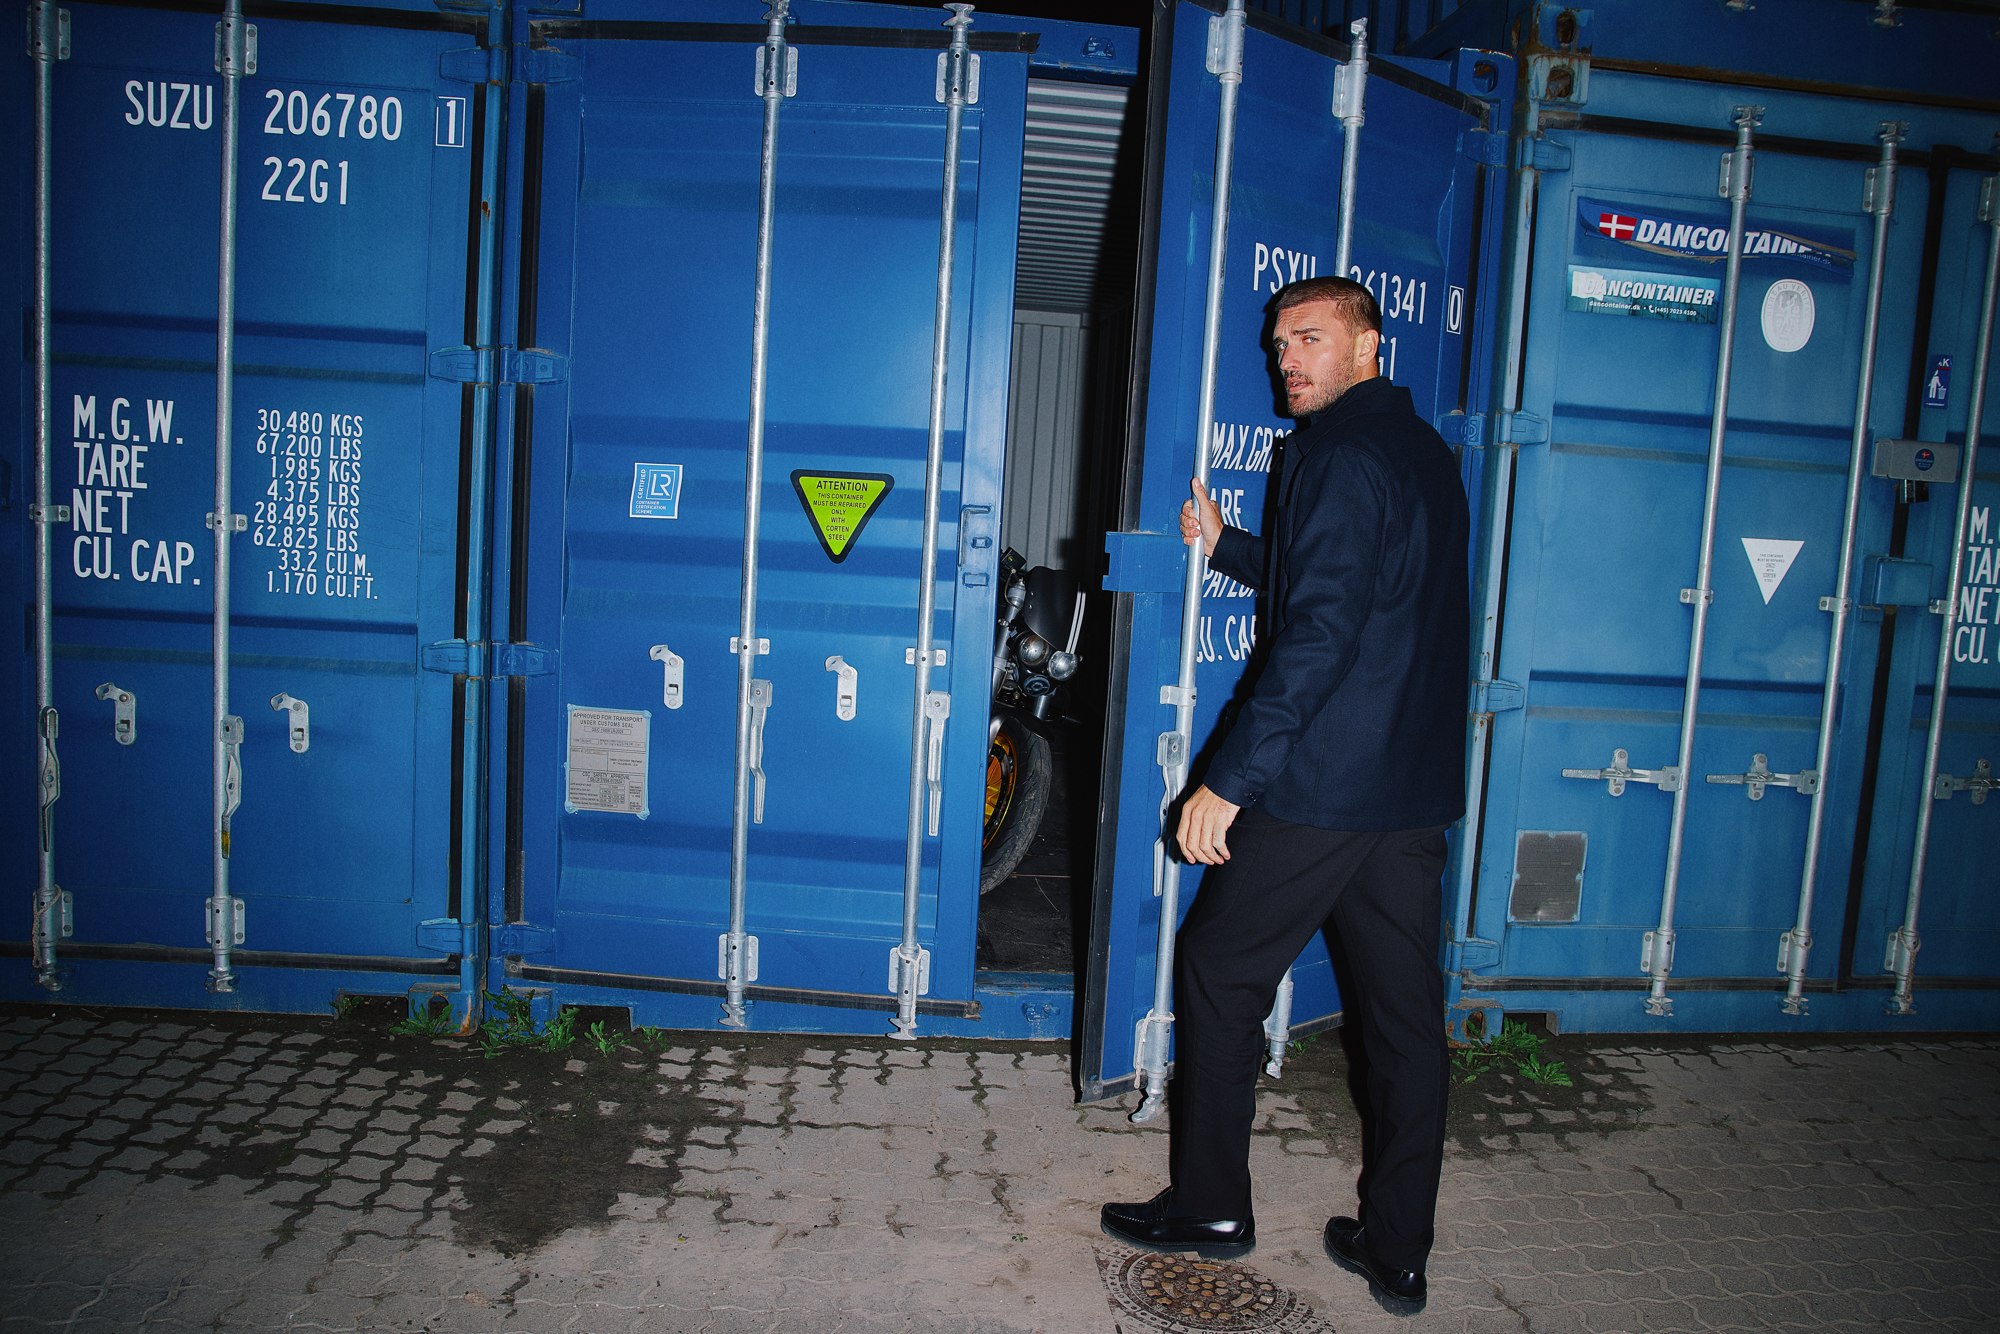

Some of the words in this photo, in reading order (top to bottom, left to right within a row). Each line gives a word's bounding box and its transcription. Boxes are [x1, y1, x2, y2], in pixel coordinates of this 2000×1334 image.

[125, 80, 213, 130] SUZU
[264, 89, 403, 141] 206780
[446, 99, 456, 145] 1
[262, 156, 349, 205] 22G1
[1584, 278, 1715, 305] DANCONTAINER
[1589, 300, 1641, 310] dancontainer.dk
[1450, 289, 1462, 331] 0
[73, 395, 183, 444] M.G.W.
[257, 408, 323, 434] 30,480
[330, 413, 363, 438] KGS
[256, 432, 322, 458] 67,200
[329, 436, 362, 461] LBS
[73, 441, 148, 489] TARE
[271, 456, 321, 481] 1,985
[328, 459, 361, 484] KGS
[267, 479, 320, 504] 4,375
[328, 482, 360, 507] LBS
[637, 469, 646, 499] CERTIFIED
[651, 474, 671, 497] LR
[816, 480, 868, 492] ATTENTION
[832, 493, 864, 501] CONTAINER
[73, 488, 133, 534] NET
[254, 501, 319, 527] 28,495
[327, 505, 359, 530] KGS
[838, 501, 866, 509] REPAIRED
[253, 524, 318, 550] 62,825
[326, 529, 358, 553] LBS
[73, 535, 120, 580] CU.
[131, 539, 200, 586] CAP.
[278, 549, 318, 573] 33.2
[267, 570, 317, 595] 1,170
[1954, 626, 1988, 664] CU.
